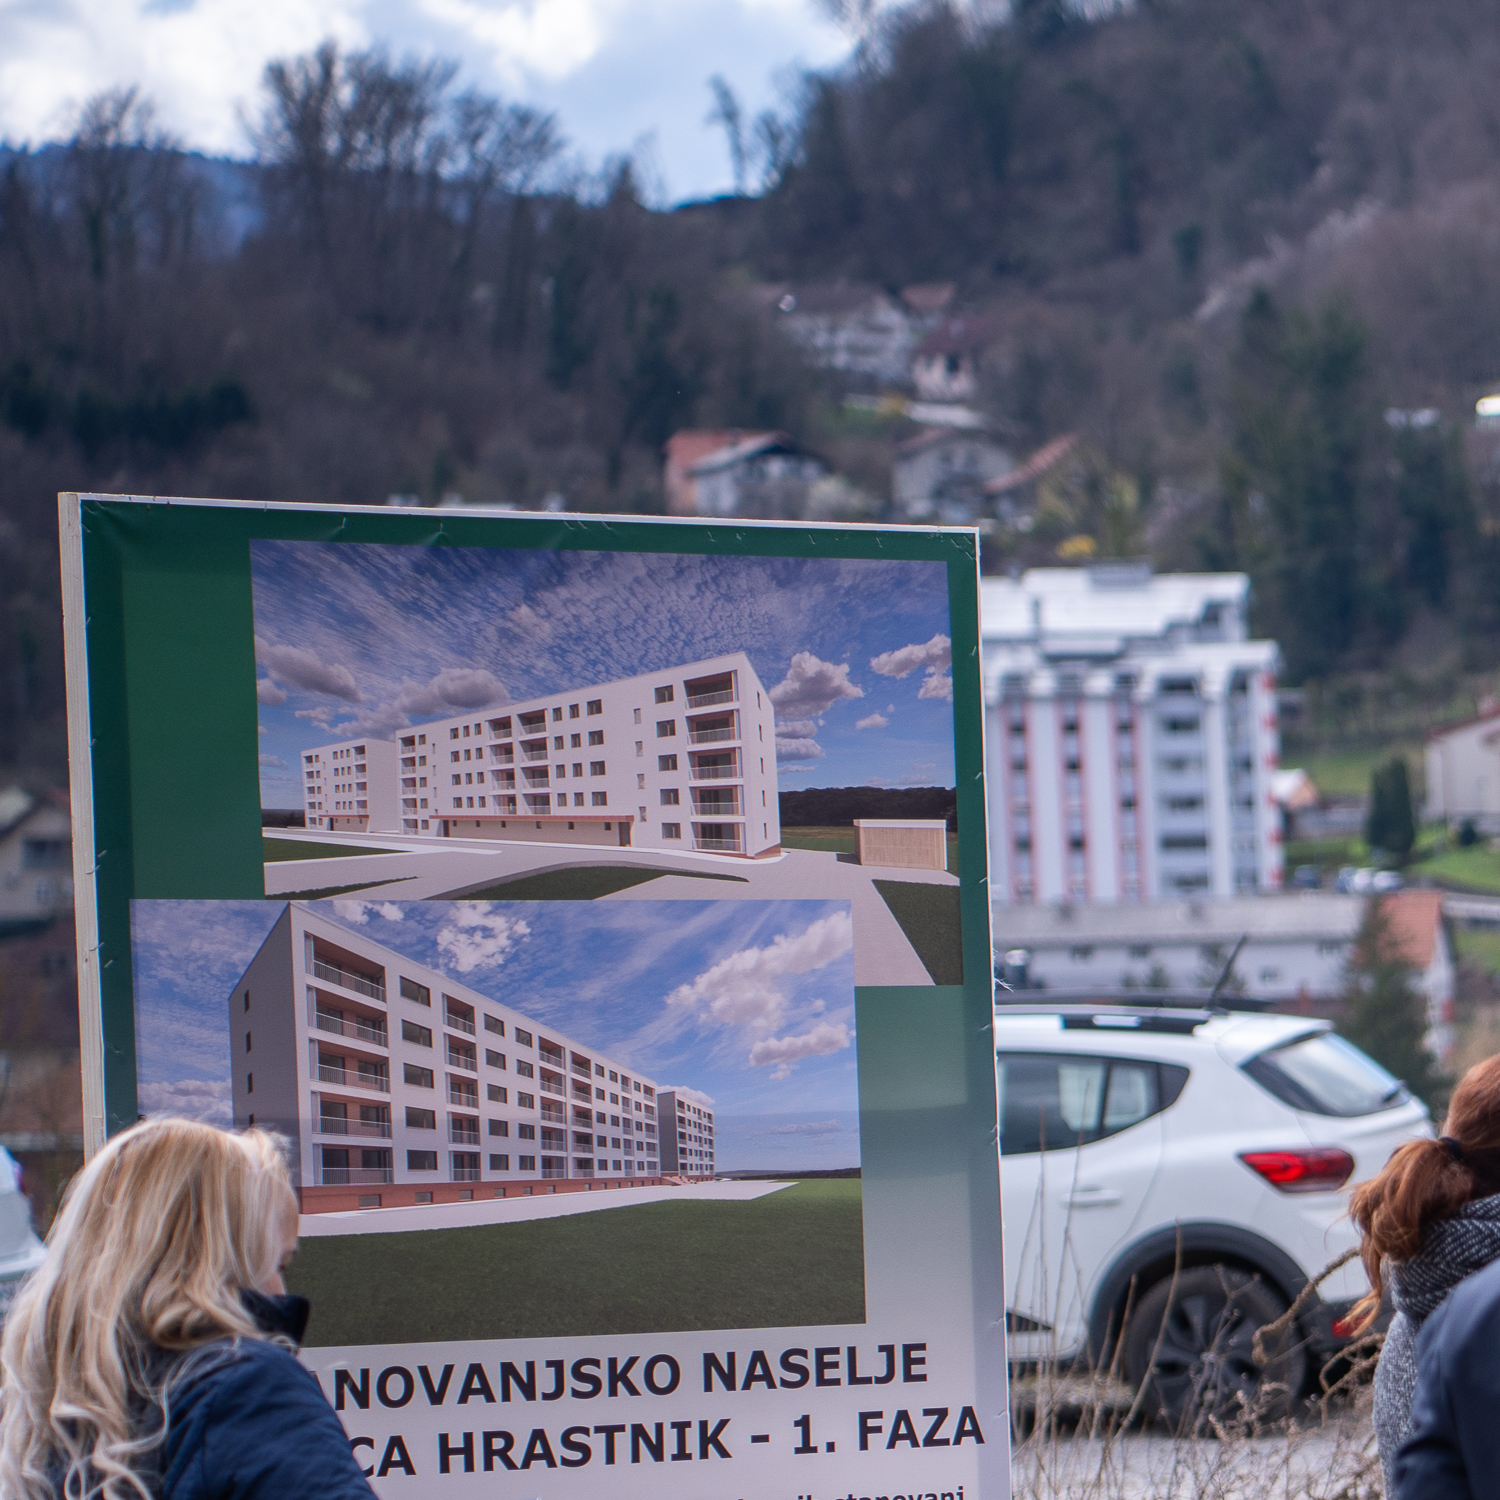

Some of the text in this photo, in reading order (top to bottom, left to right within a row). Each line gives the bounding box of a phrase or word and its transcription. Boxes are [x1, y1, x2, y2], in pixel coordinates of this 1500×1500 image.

[309, 1342, 928, 1411] NOVANJSKO NASELJE
[438, 1418, 733, 1475] HRASTNIK
[750, 1434, 770, 1444] -
[793, 1414, 836, 1455] 1.
[858, 1405, 986, 1451] FAZA
